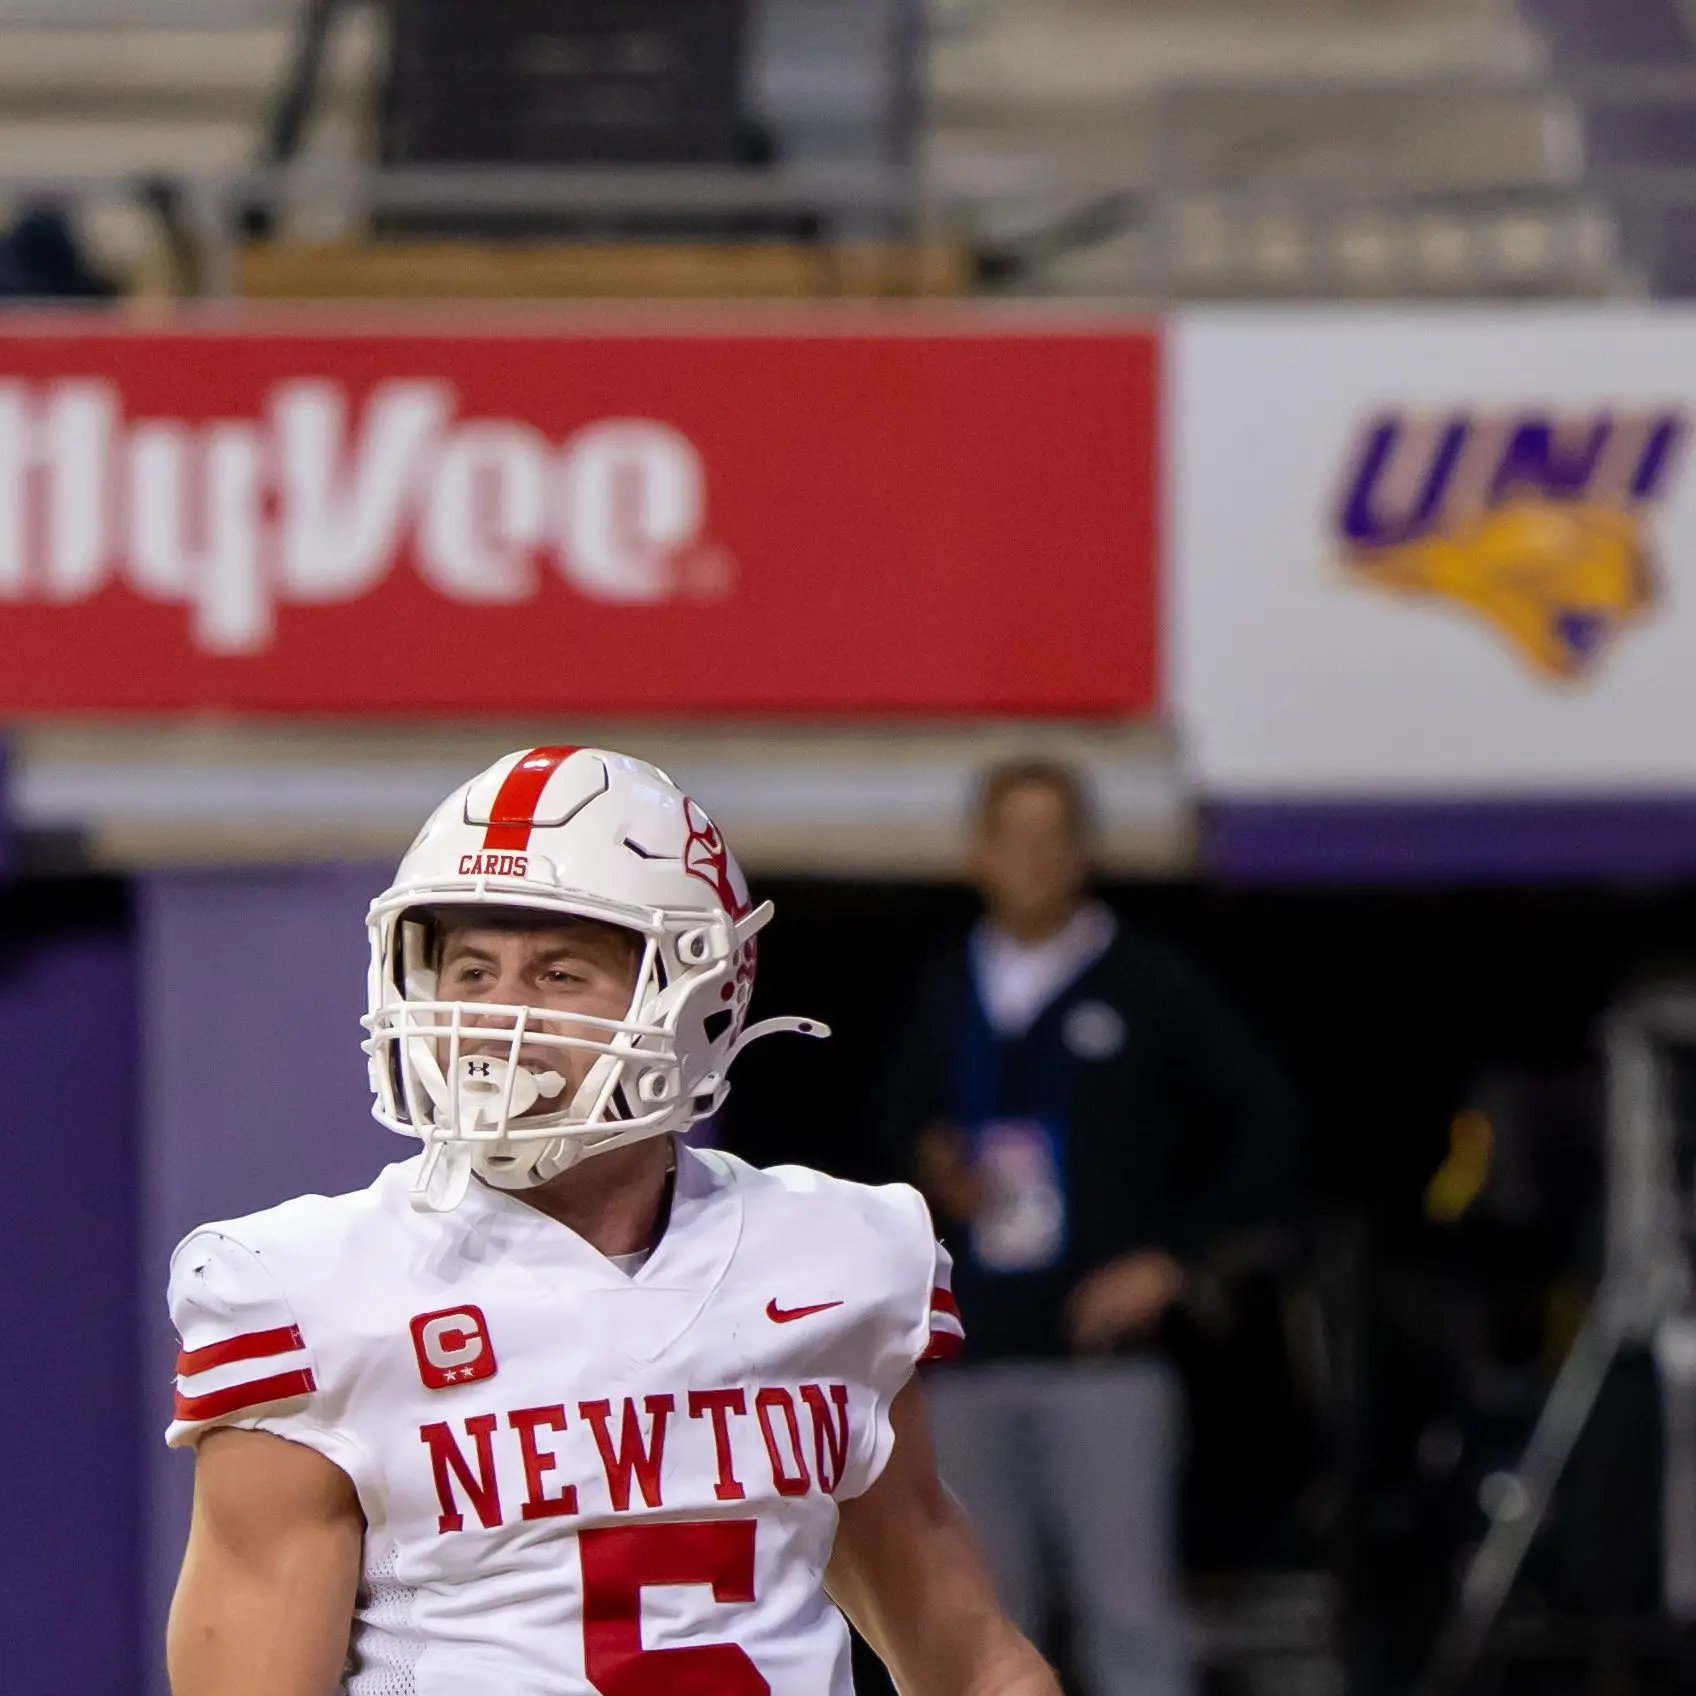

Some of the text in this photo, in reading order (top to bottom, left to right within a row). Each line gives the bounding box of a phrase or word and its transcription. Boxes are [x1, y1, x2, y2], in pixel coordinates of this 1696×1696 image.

[1332, 408, 1690, 546] UNI
[458, 854, 528, 877] CARDS
[423, 1313, 482, 1369] C
[420, 1384, 848, 1533] NEWTON
